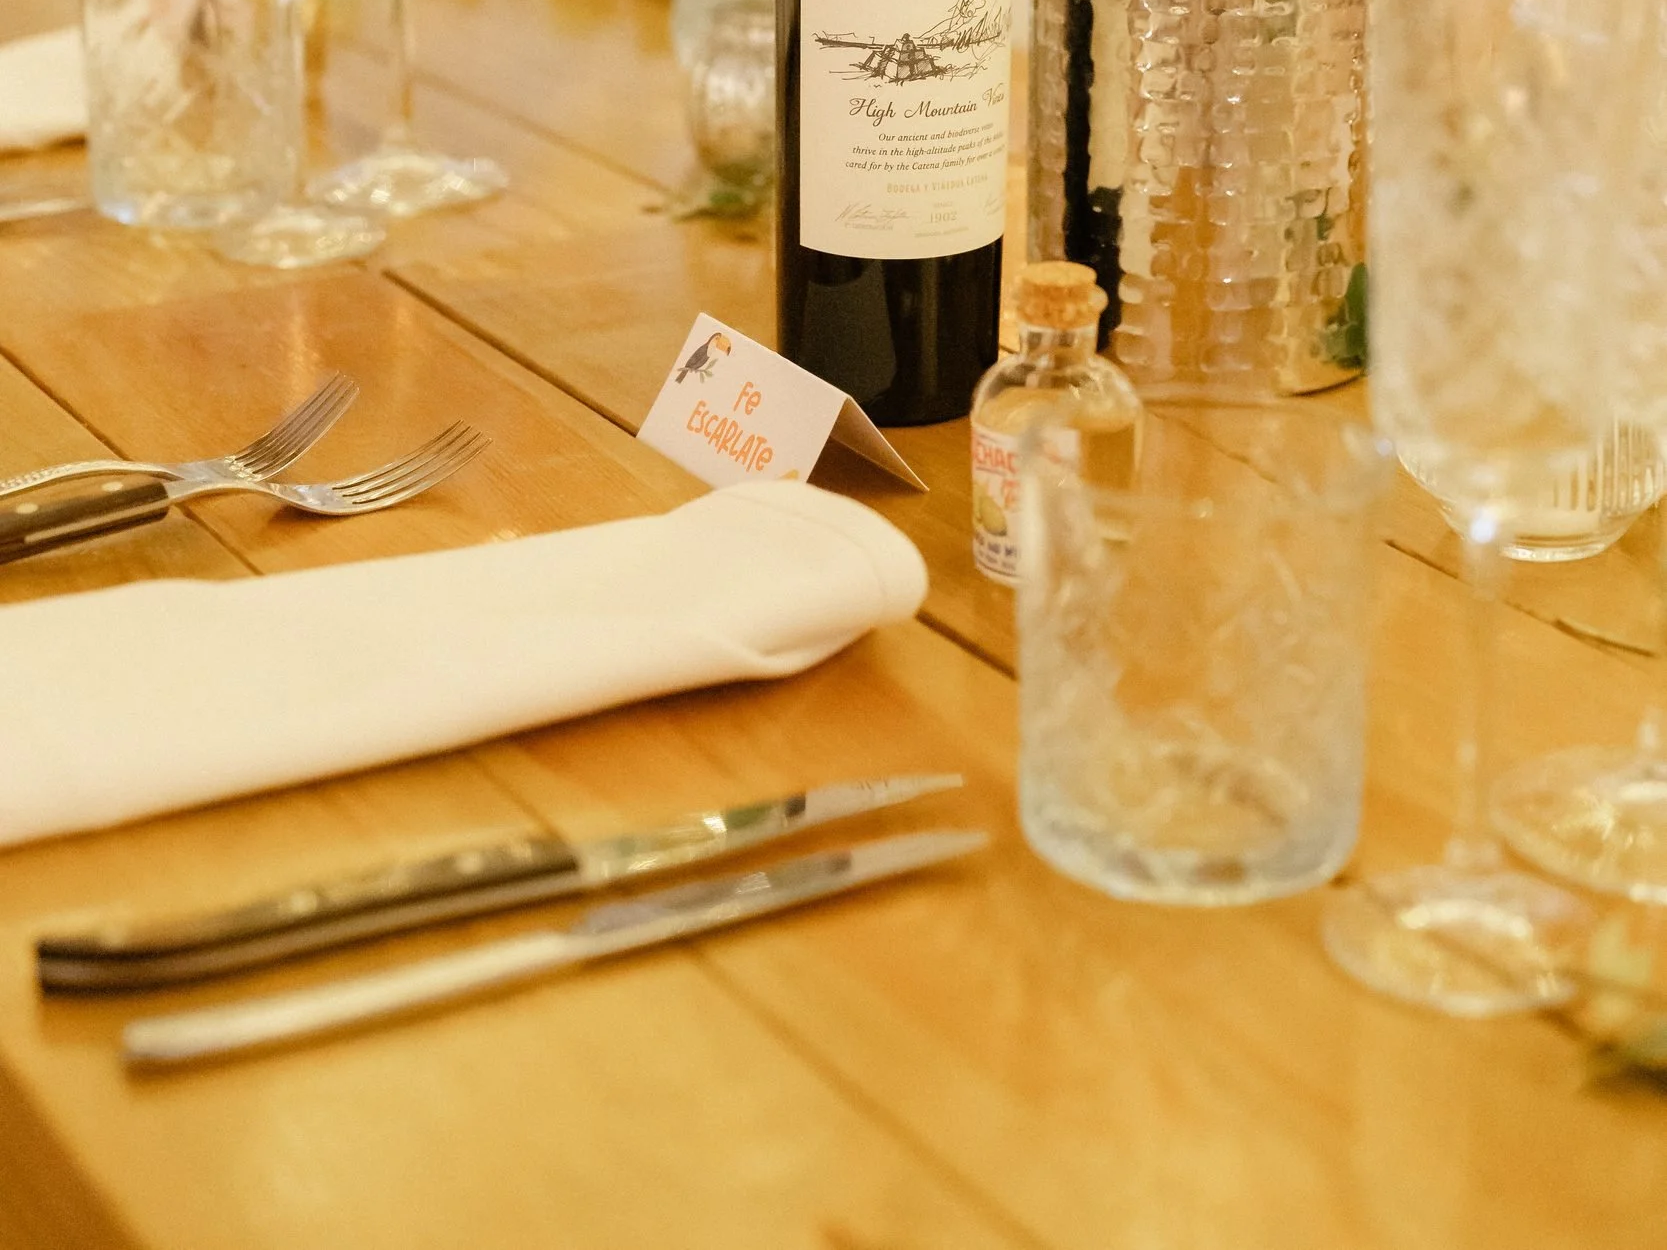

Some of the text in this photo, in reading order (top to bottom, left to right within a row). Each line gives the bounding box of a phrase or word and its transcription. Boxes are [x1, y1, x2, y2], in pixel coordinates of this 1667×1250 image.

[849, 97, 896, 127] High
[903, 101, 978, 119] Mountain
[878, 133, 896, 142] Our
[897, 133, 929, 142] ancient
[930, 131, 946, 141] and
[852, 146, 877, 156] thrive
[879, 147, 888, 156] in
[890, 147, 904, 156] the
[905, 144, 956, 158] high-altitude
[845, 161, 867, 170] cared
[867, 161, 882, 172] for
[884, 162, 894, 172] by
[896, 162, 910, 171] the
[911, 161, 940, 171] Catena
[940, 157, 965, 170] family
